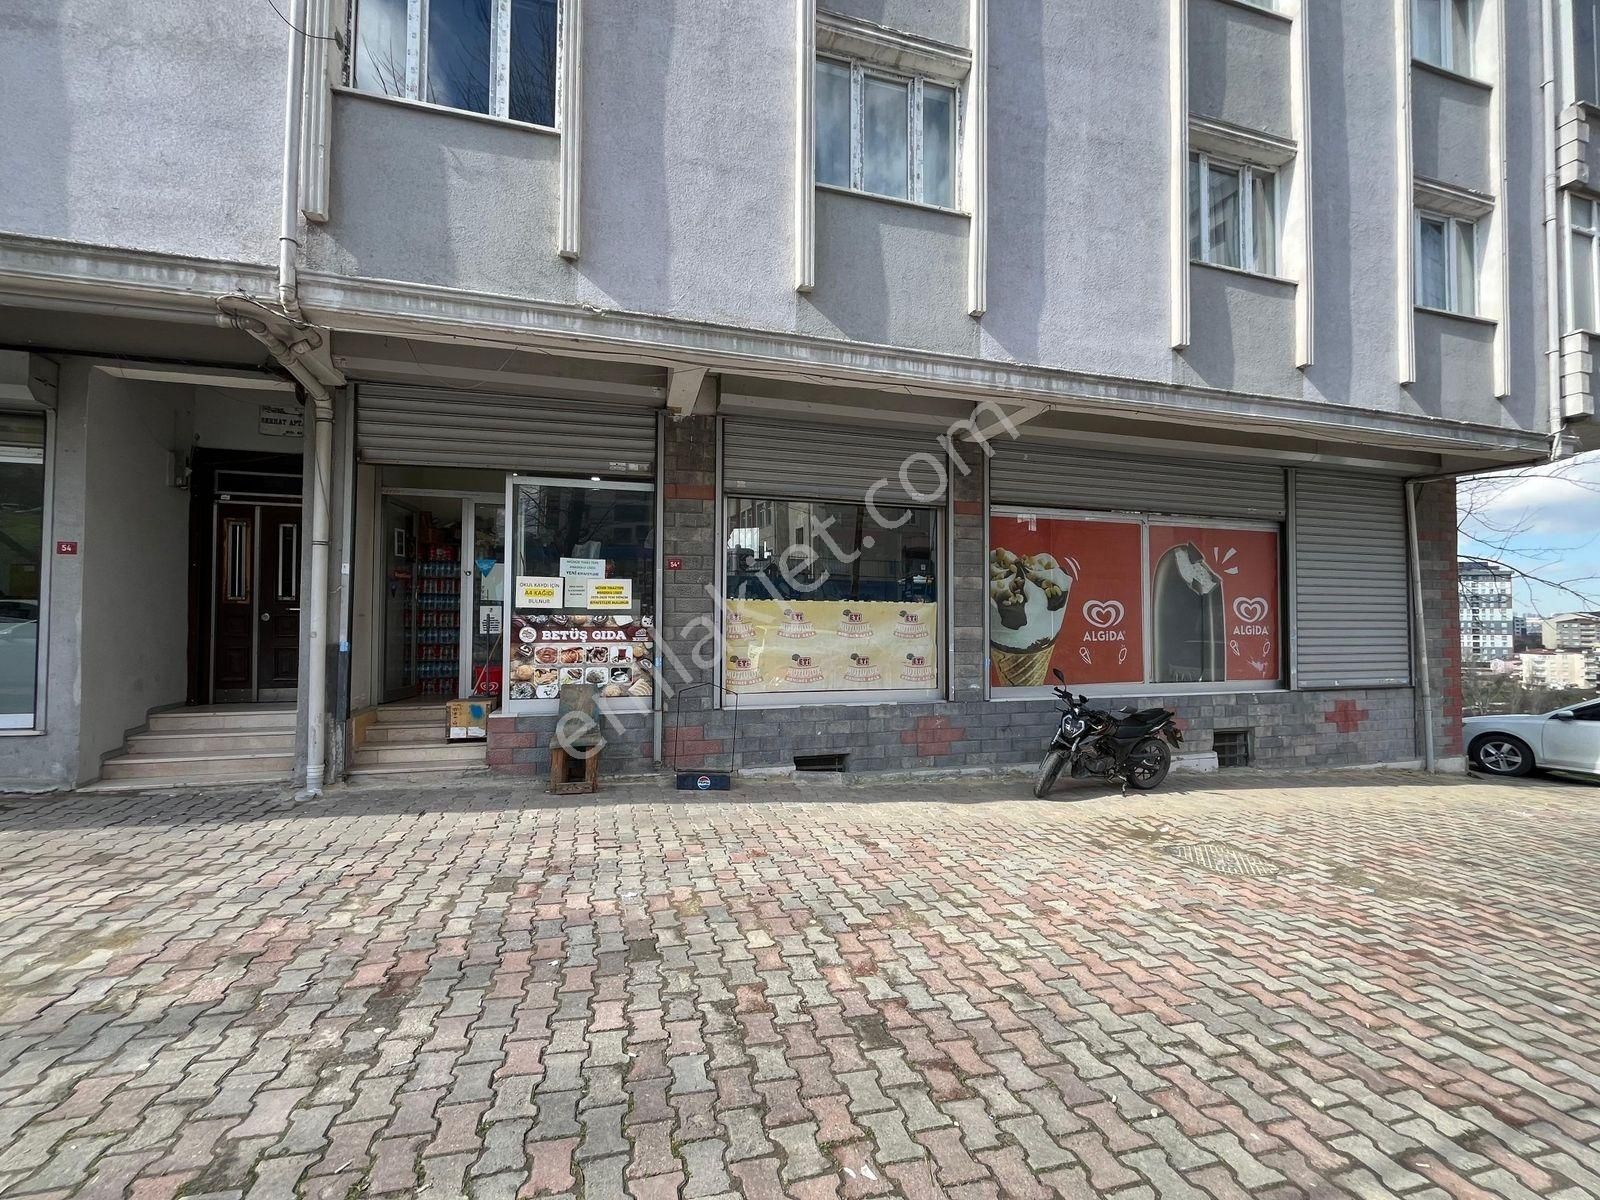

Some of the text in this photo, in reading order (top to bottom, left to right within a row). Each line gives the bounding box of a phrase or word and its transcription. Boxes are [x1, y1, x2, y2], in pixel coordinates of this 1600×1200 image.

[61, 544, 71, 552] 54
[541, 627, 627, 642] BETÜŞ GIDA
